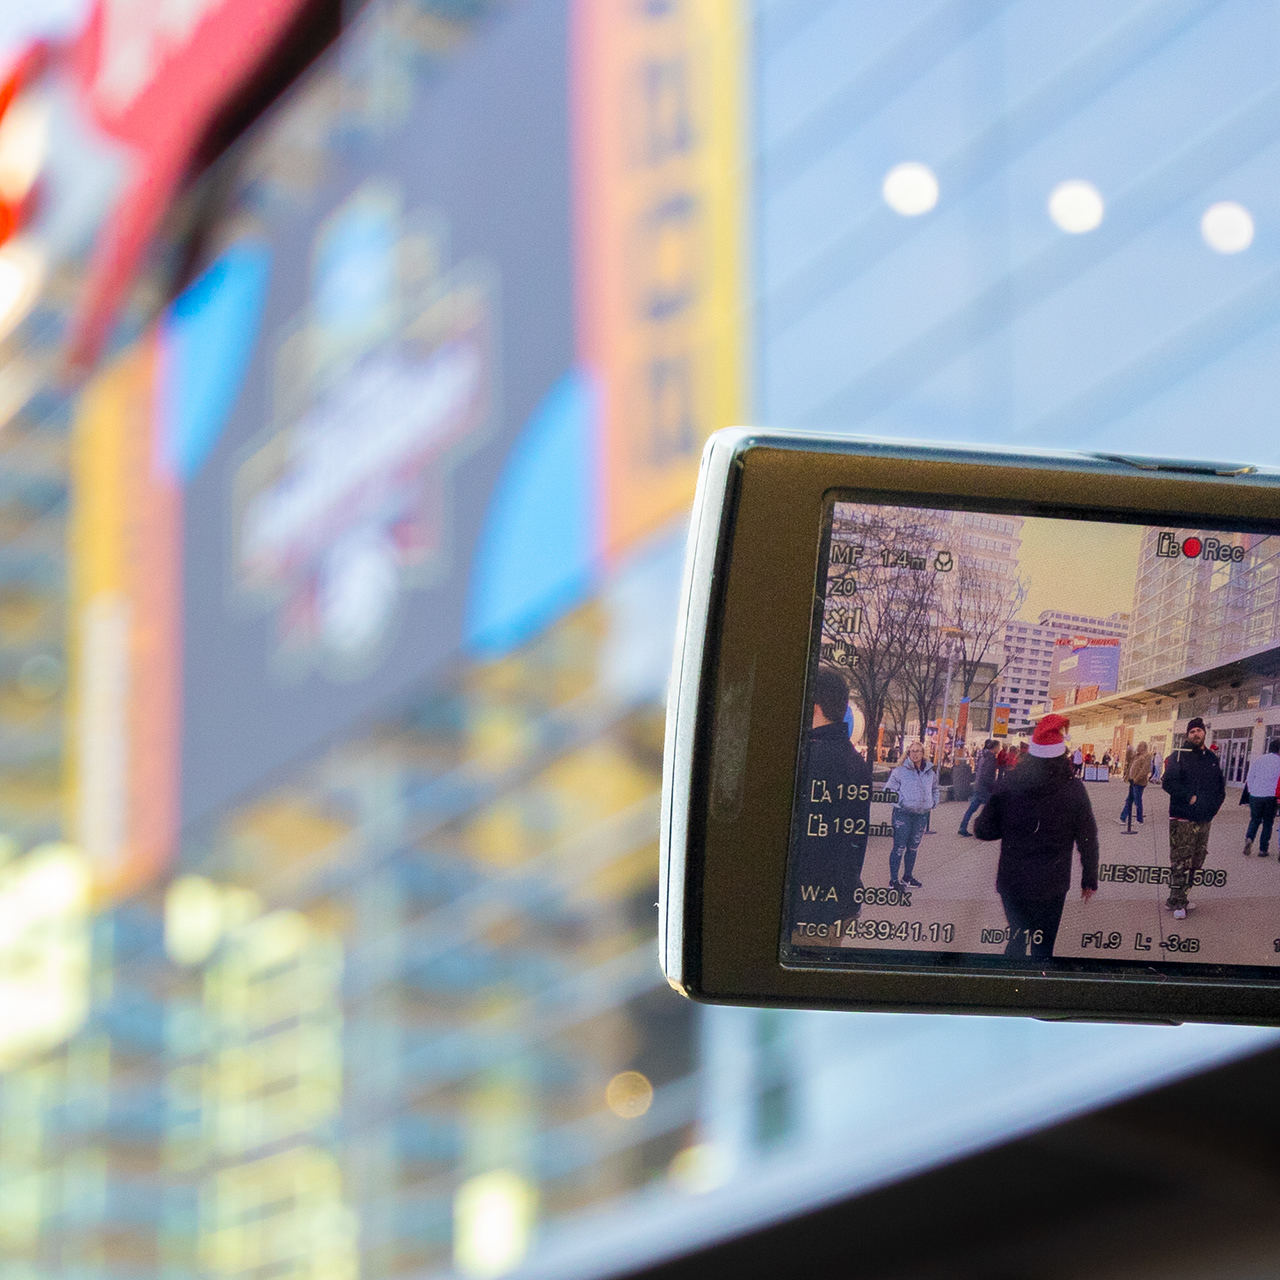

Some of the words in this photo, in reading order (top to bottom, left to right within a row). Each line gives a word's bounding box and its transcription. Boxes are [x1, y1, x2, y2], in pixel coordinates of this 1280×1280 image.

[831, 544, 863, 565] MF
[1203, 538, 1245, 562] Rec
[838, 653, 860, 667] OFF
[836, 783, 871, 802] 195
[872, 788, 899, 804] min
[832, 817, 867, 836] 192
[869, 822, 896, 838] min
[800, 885, 839, 903] W:A
[797, 922, 829, 938] TCG
[832, 918, 956, 944] 14:39:41.11
[1081, 931, 1122, 950] F1.9
[1158, 934, 1200, 953] -3dB
